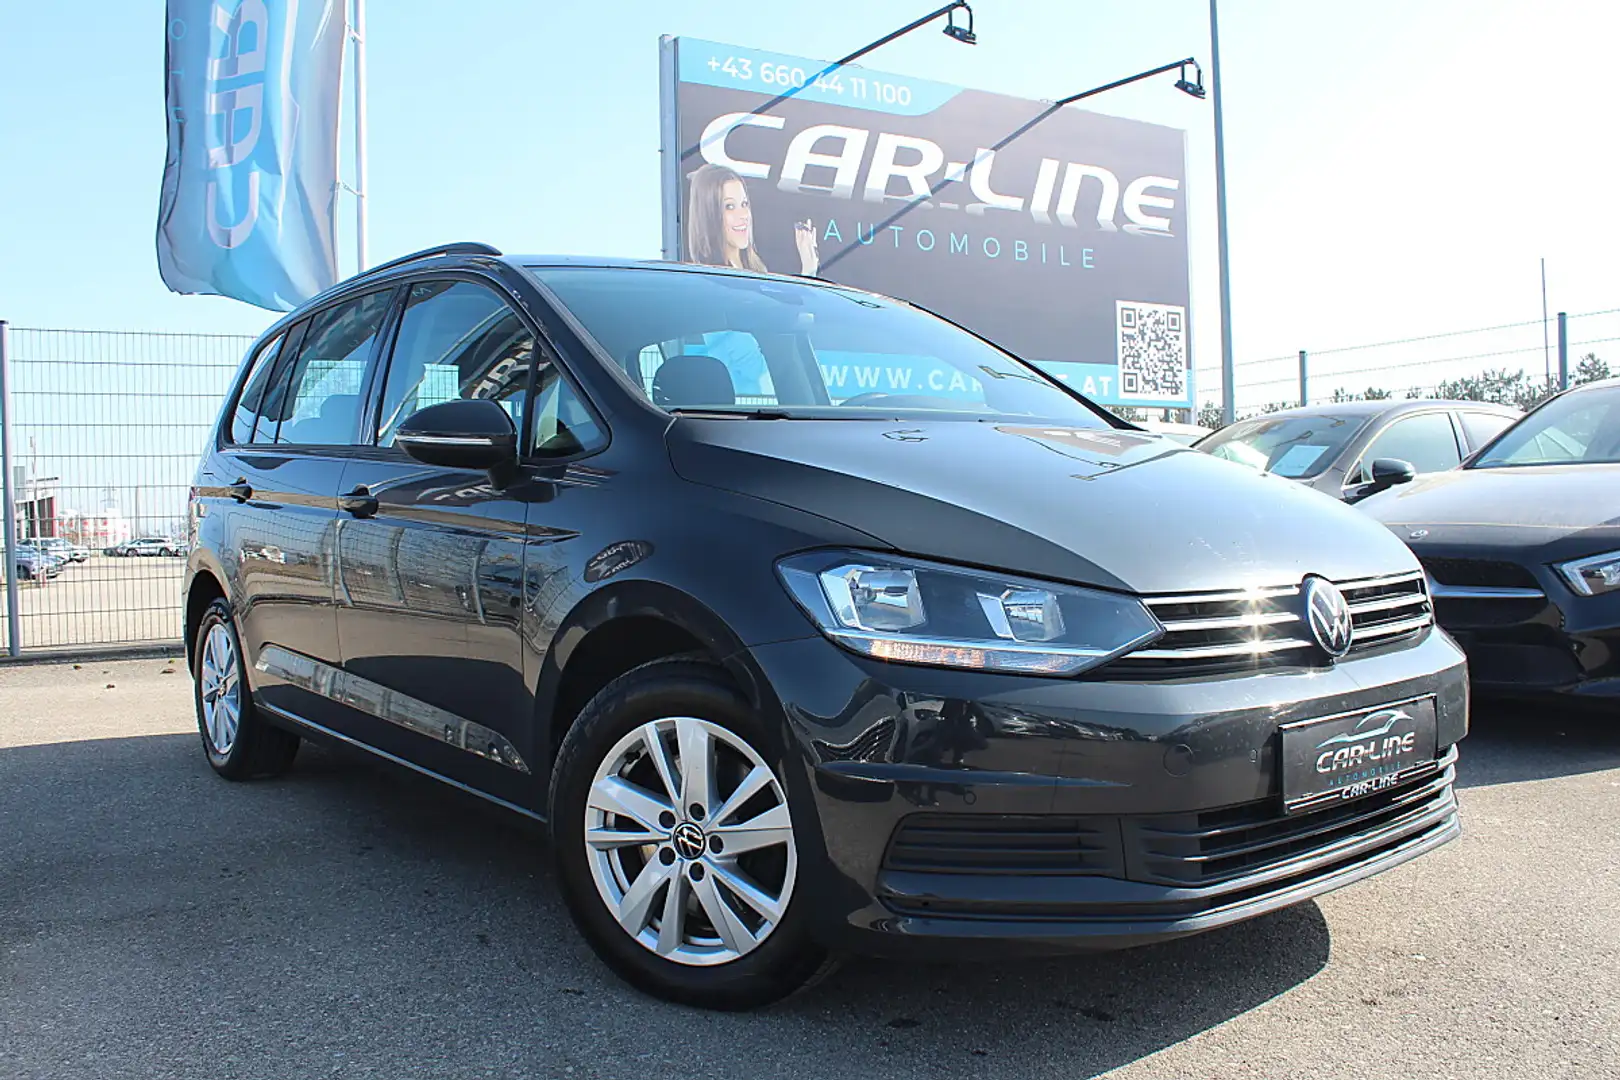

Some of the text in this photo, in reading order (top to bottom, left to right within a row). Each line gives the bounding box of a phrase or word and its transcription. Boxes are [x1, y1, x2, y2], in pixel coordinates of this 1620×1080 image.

[707, 56, 911, 106] +43 660 44 11 100
[699, 112, 1180, 236] CAR-LINE
[823, 219, 1096, 269] AUTOMOBILE
[1316, 732, 1415, 774] CAR-LINE
[1341, 773, 1399, 800] CAR-LINE
